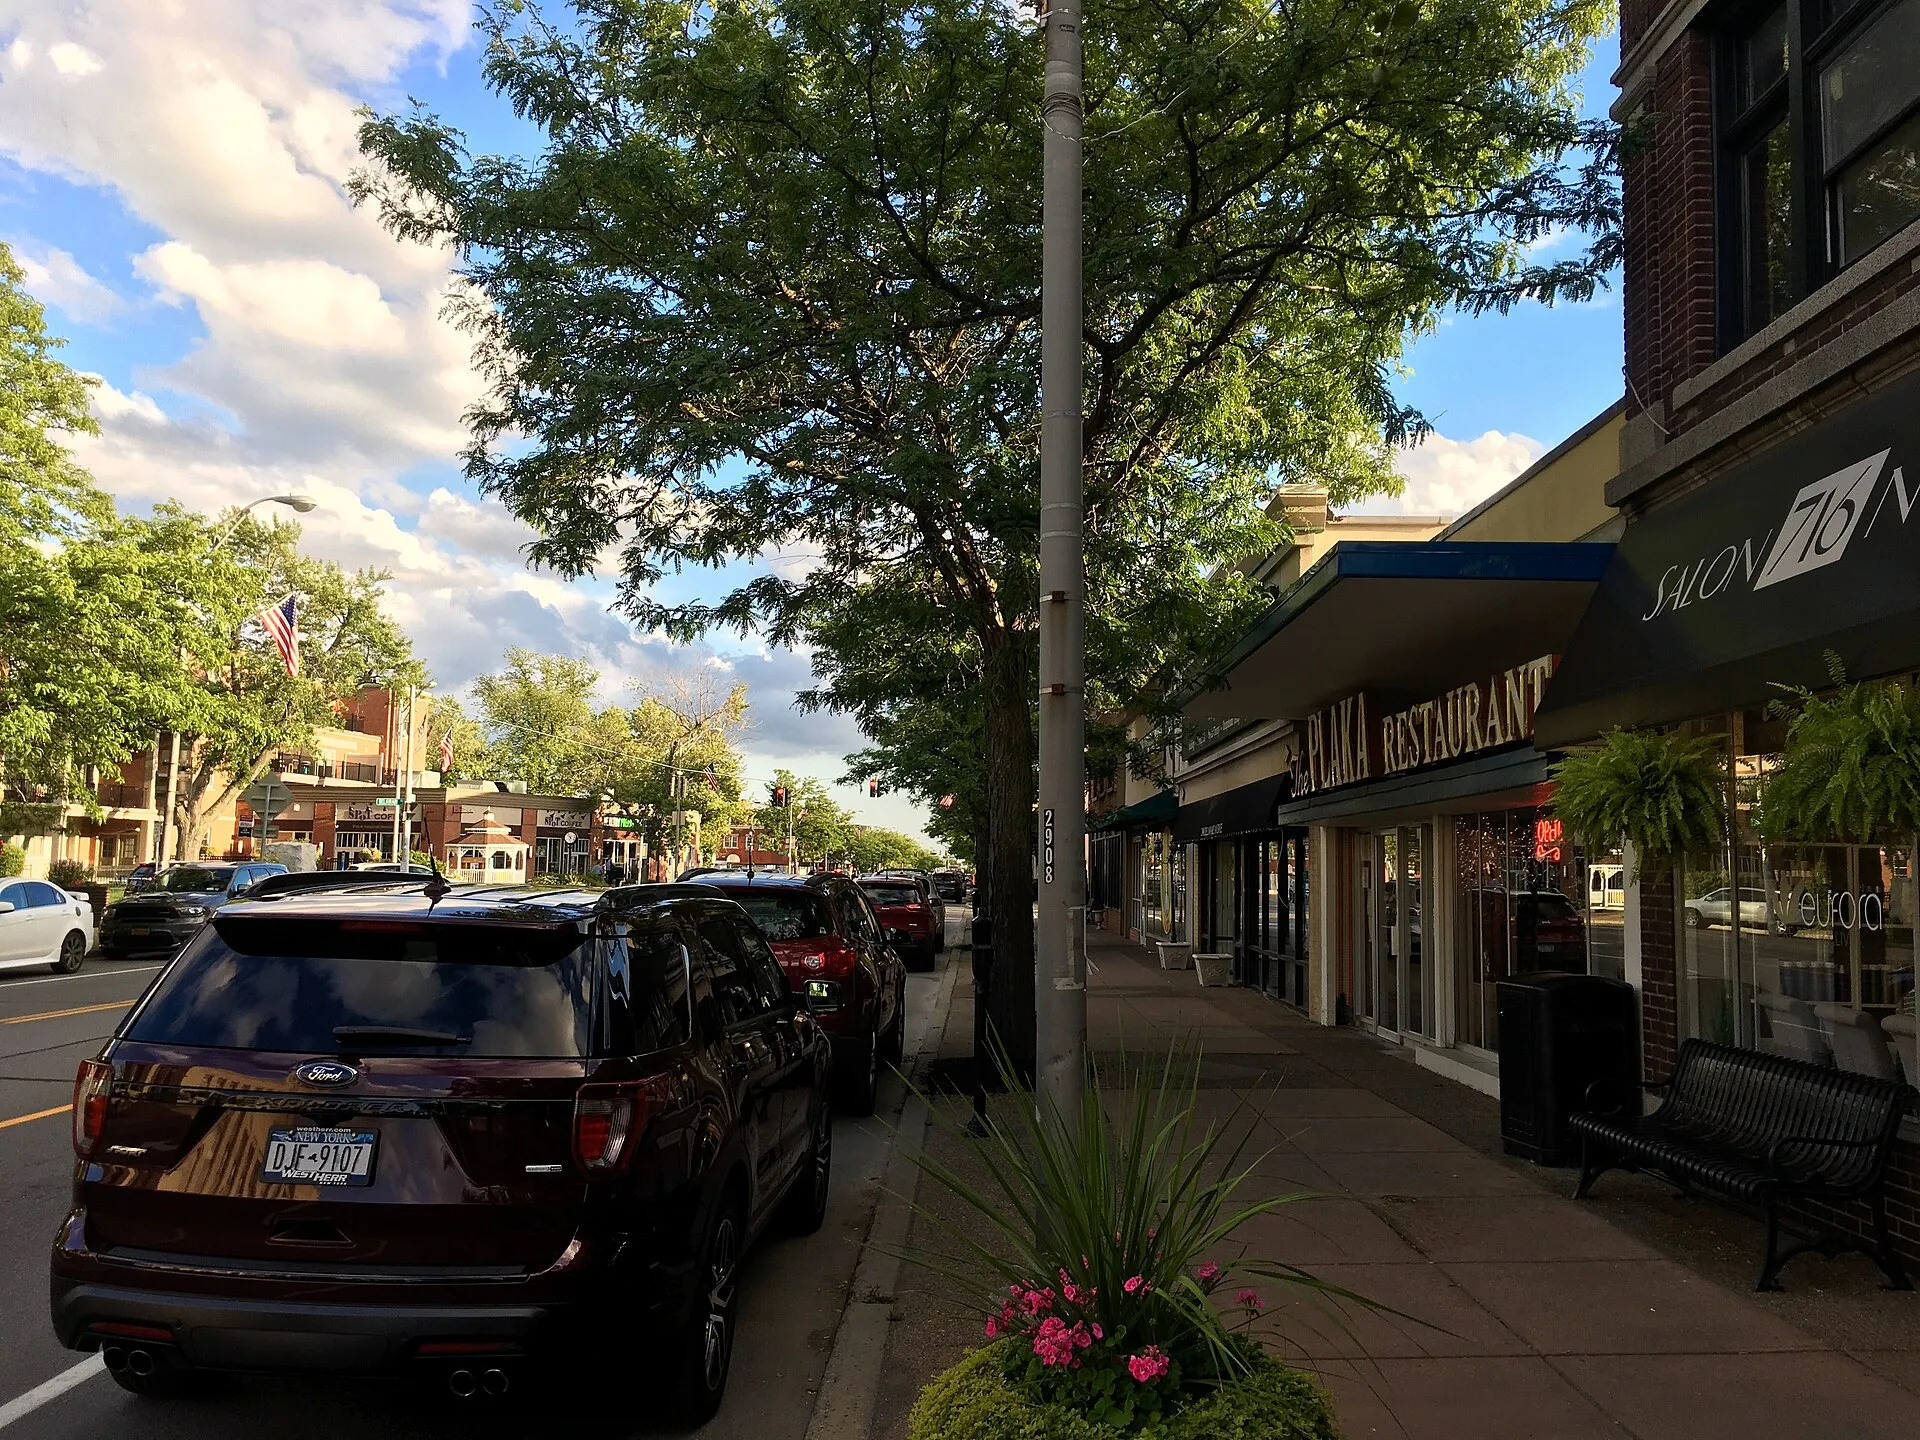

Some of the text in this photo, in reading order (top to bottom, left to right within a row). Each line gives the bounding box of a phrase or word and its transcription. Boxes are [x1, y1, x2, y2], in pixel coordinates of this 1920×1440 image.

[1641, 528, 1774, 622] SALON
[1285, 654, 1553, 798] The PLAKA RESTAURANT
[1045, 809, 1053, 883] 2908
[308, 1065, 343, 1082] Ford
[295, 1131, 351, 1144] NEW YORK
